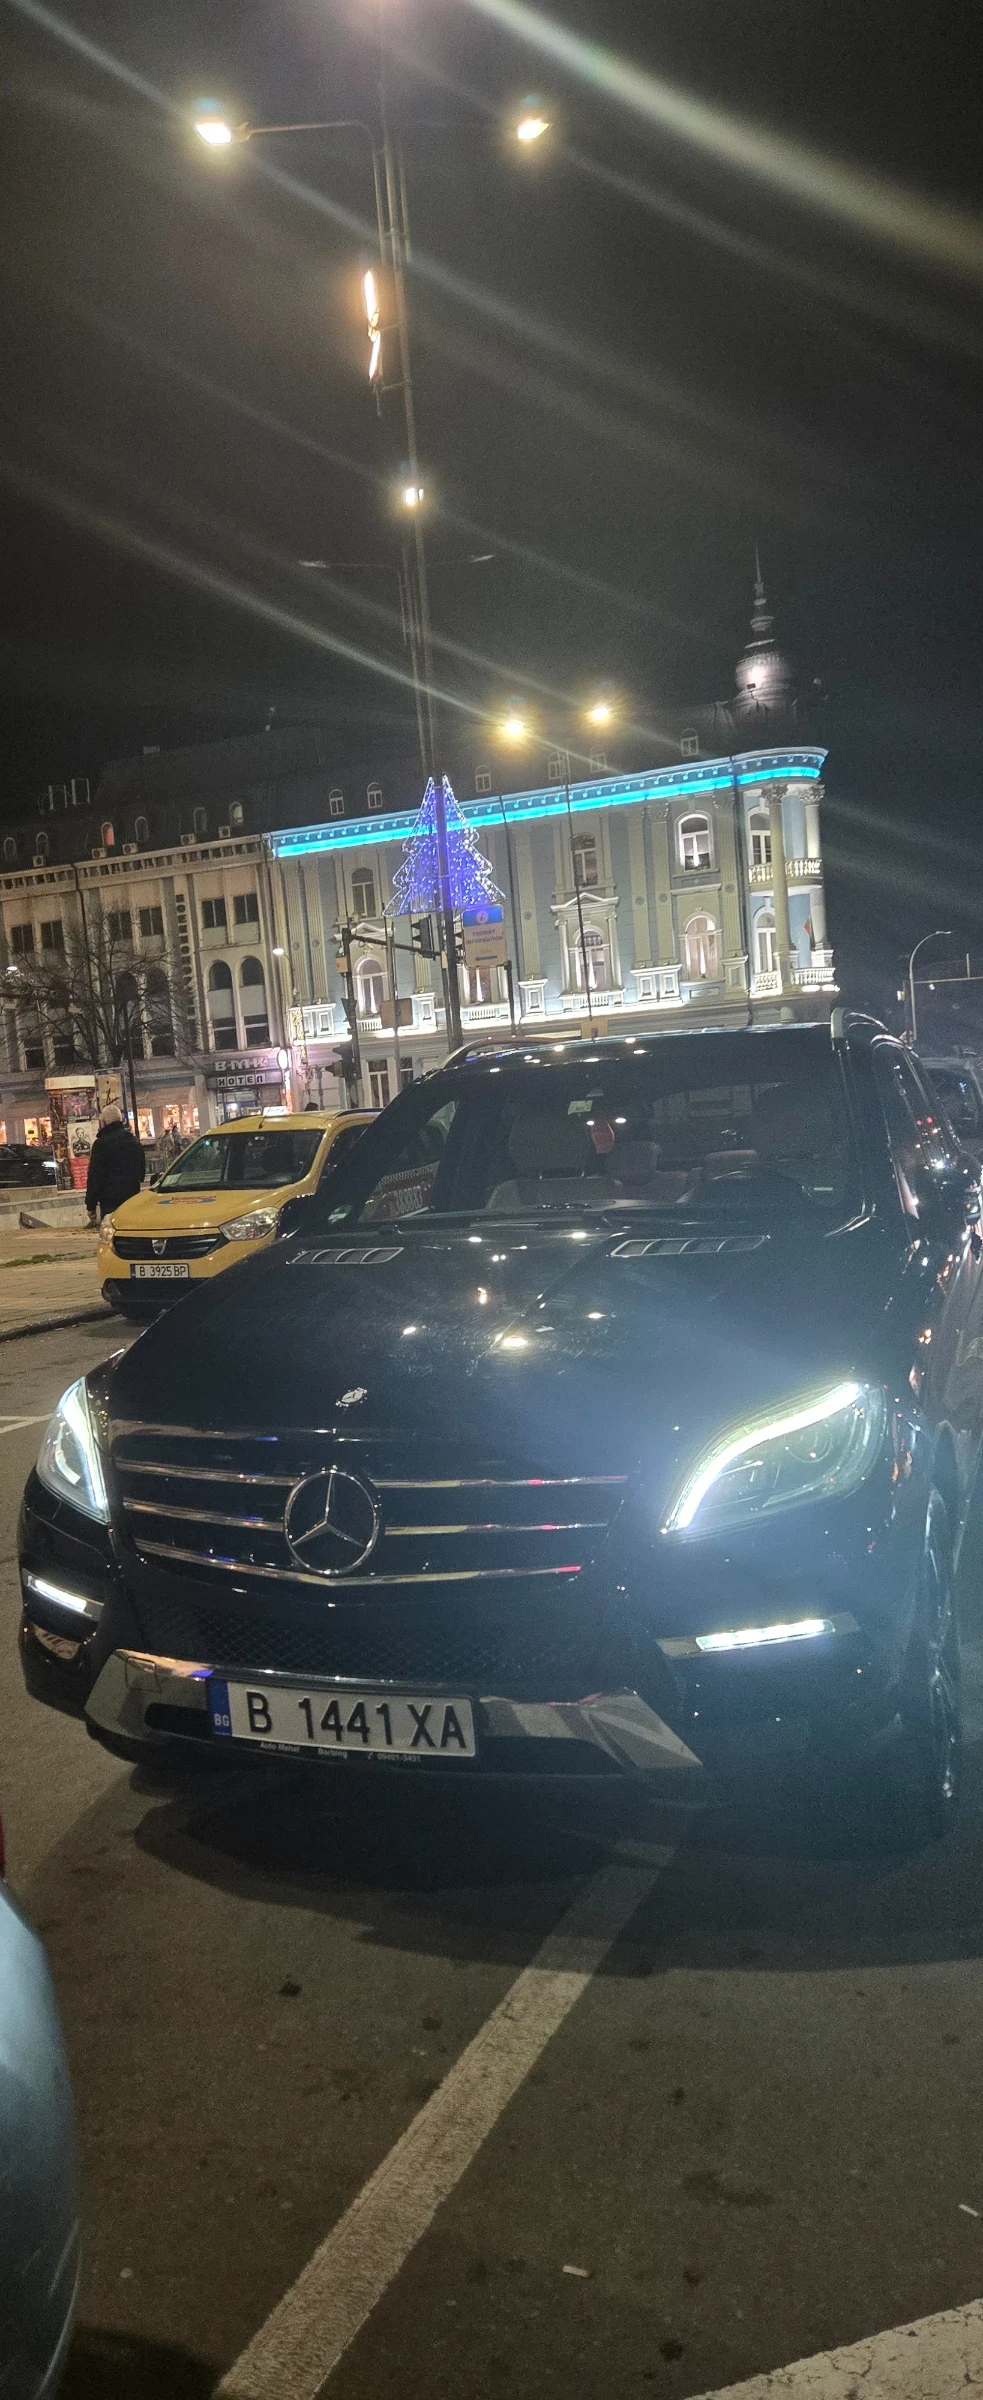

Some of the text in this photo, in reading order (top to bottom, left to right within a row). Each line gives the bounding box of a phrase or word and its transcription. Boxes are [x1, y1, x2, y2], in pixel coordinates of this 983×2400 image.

[150, 1266, 172, 1276] 3925
[214, 1713, 230, 1727] BG
[246, 1690, 467, 1748] B 1441 XA
